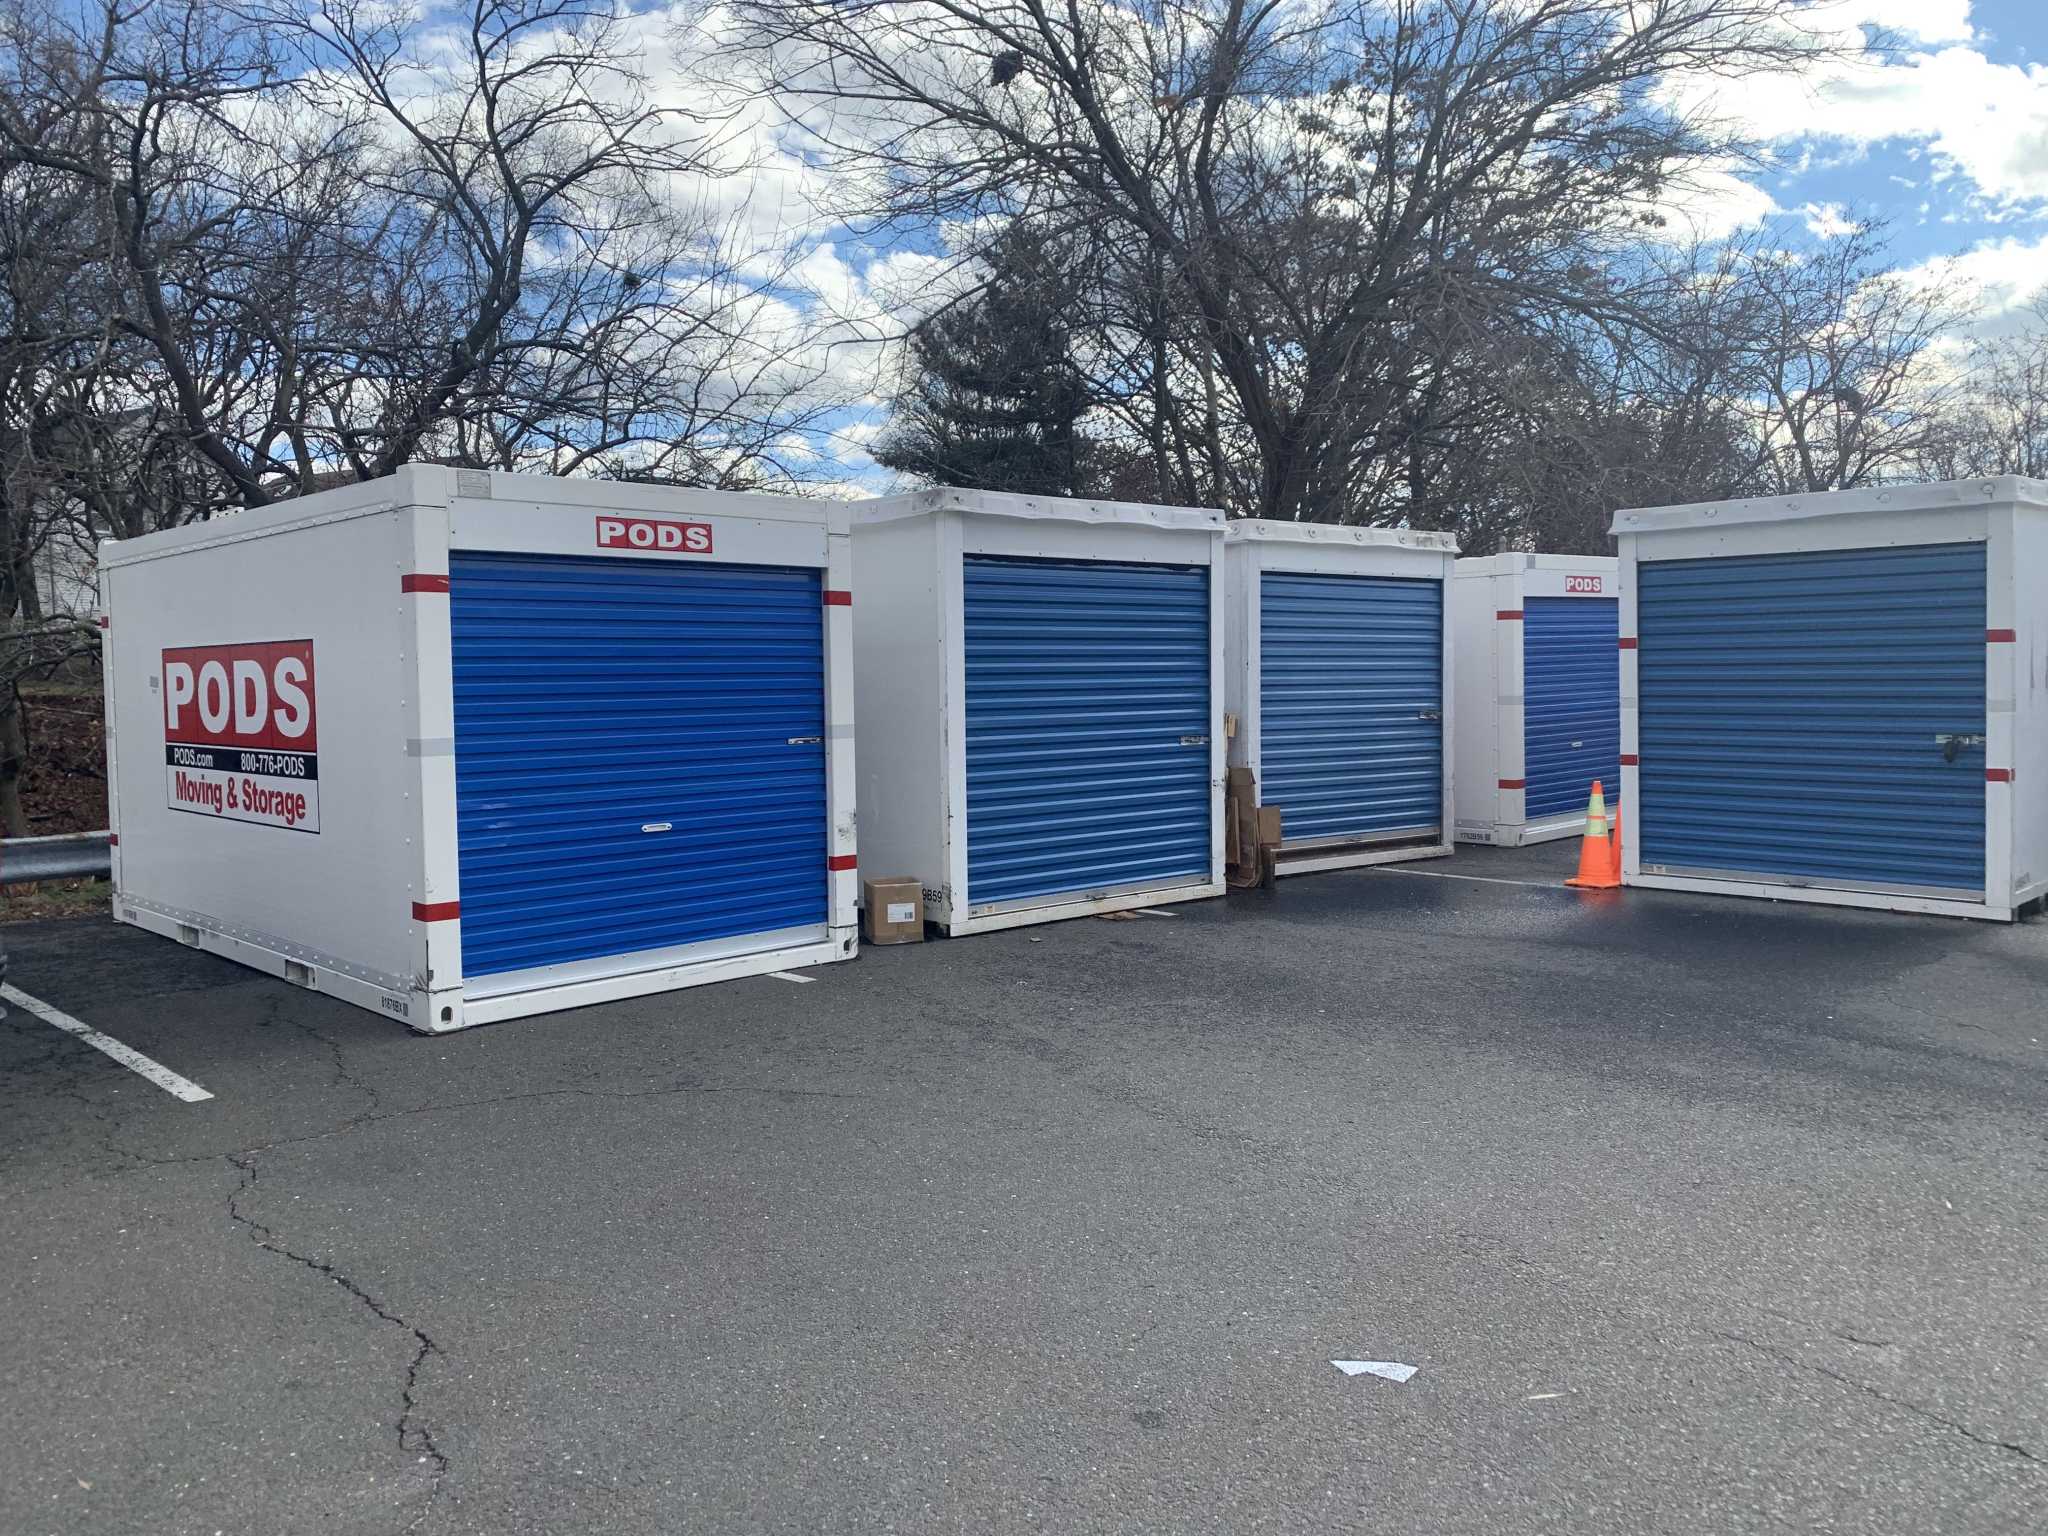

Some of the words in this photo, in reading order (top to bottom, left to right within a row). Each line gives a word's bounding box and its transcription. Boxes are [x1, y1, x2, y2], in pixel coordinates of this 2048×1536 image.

[599, 521, 709, 550] PODS
[1566, 577, 1601, 592] PODS
[165, 656, 311, 738] PODS
[174, 747, 214, 768] PODS.com
[240, 752, 305, 777] 800-776-PODS
[176, 771, 223, 814] Moving
[227, 777, 239, 809] &
[243, 778, 306, 826] Storage
